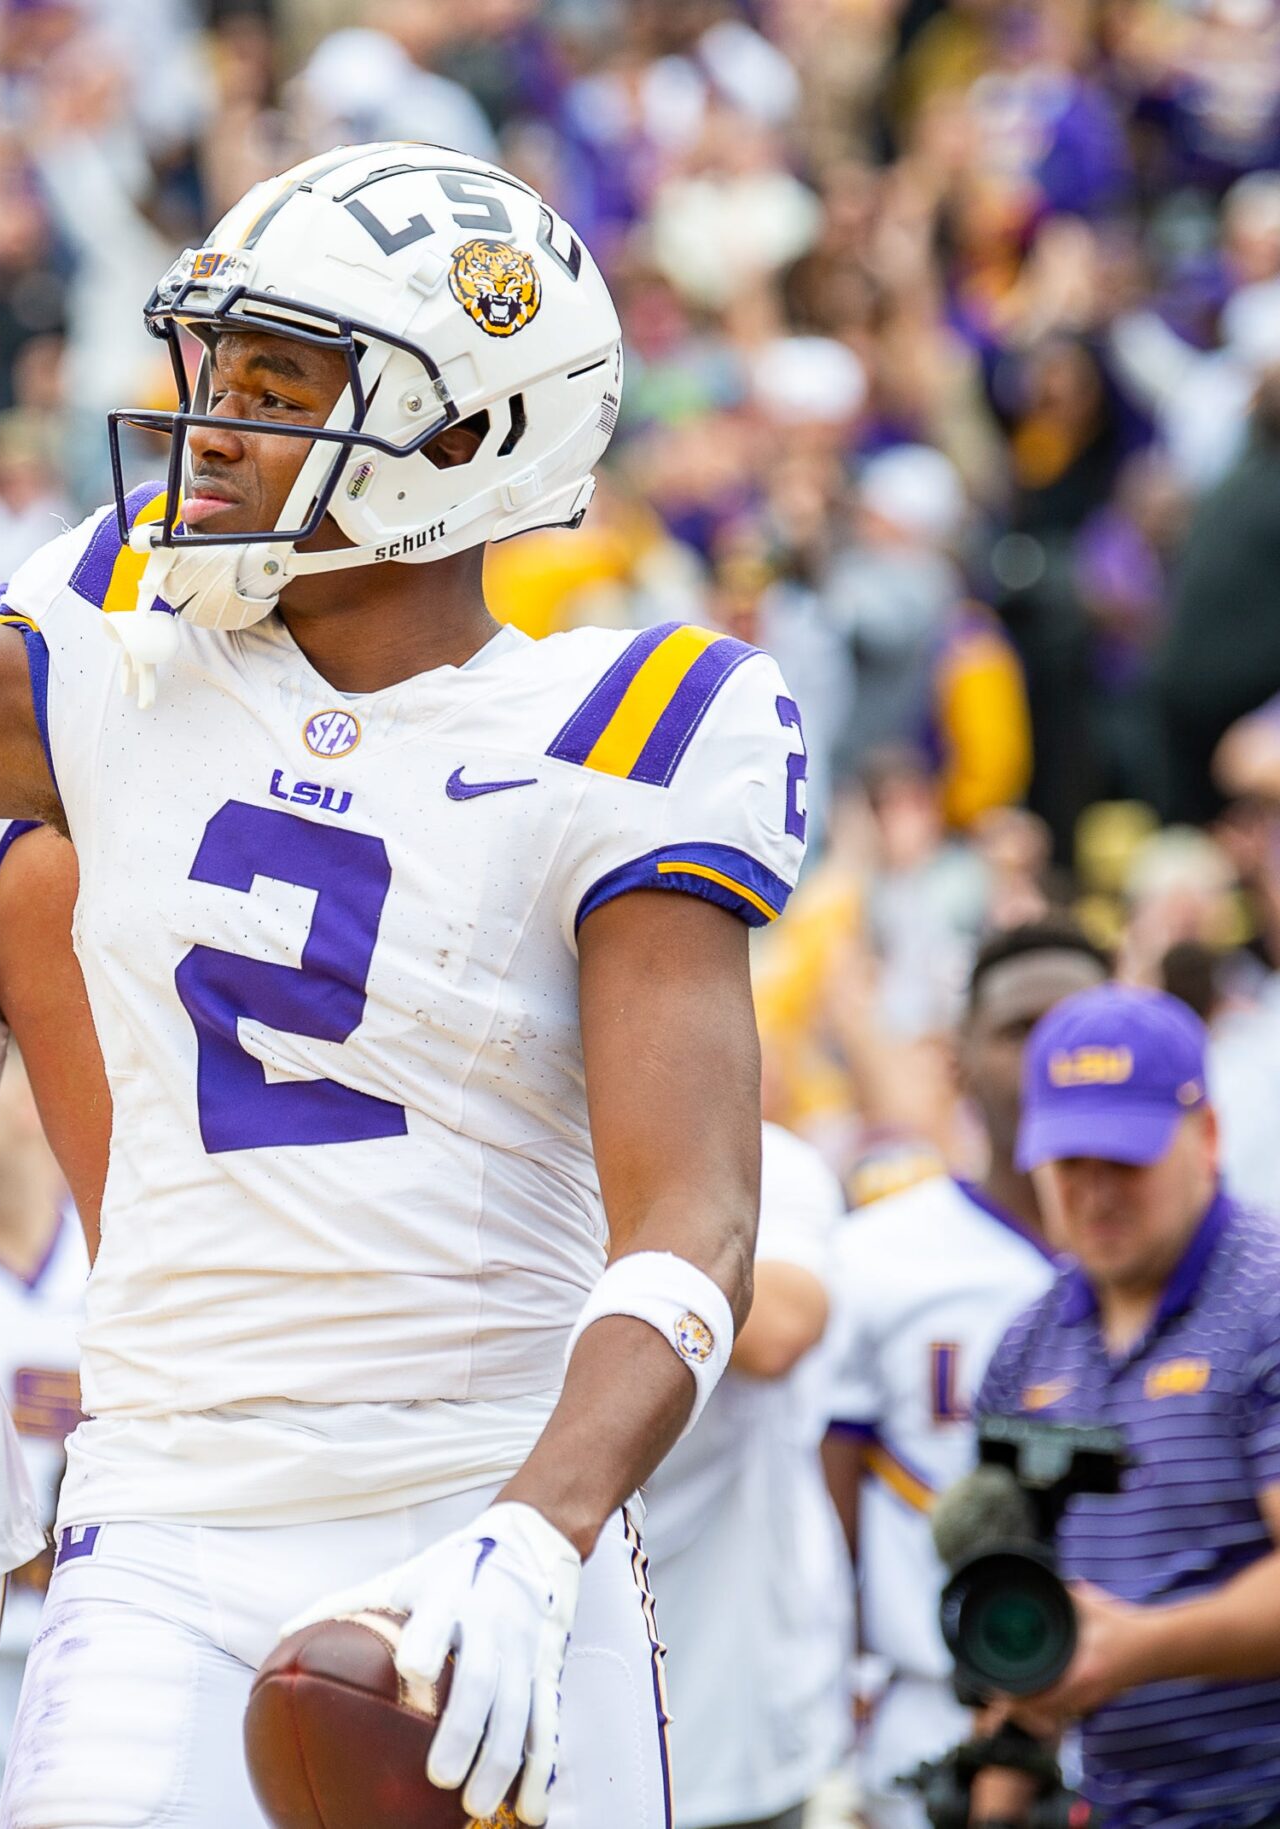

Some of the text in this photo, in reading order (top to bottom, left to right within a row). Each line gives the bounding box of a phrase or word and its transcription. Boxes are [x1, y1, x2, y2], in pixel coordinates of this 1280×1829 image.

[351, 465, 370, 499] schutt
[374, 520, 446, 561] schutt
[306, 711, 359, 756] SEC
[269, 768, 354, 814] LSU
[174, 799, 409, 1154] 2
